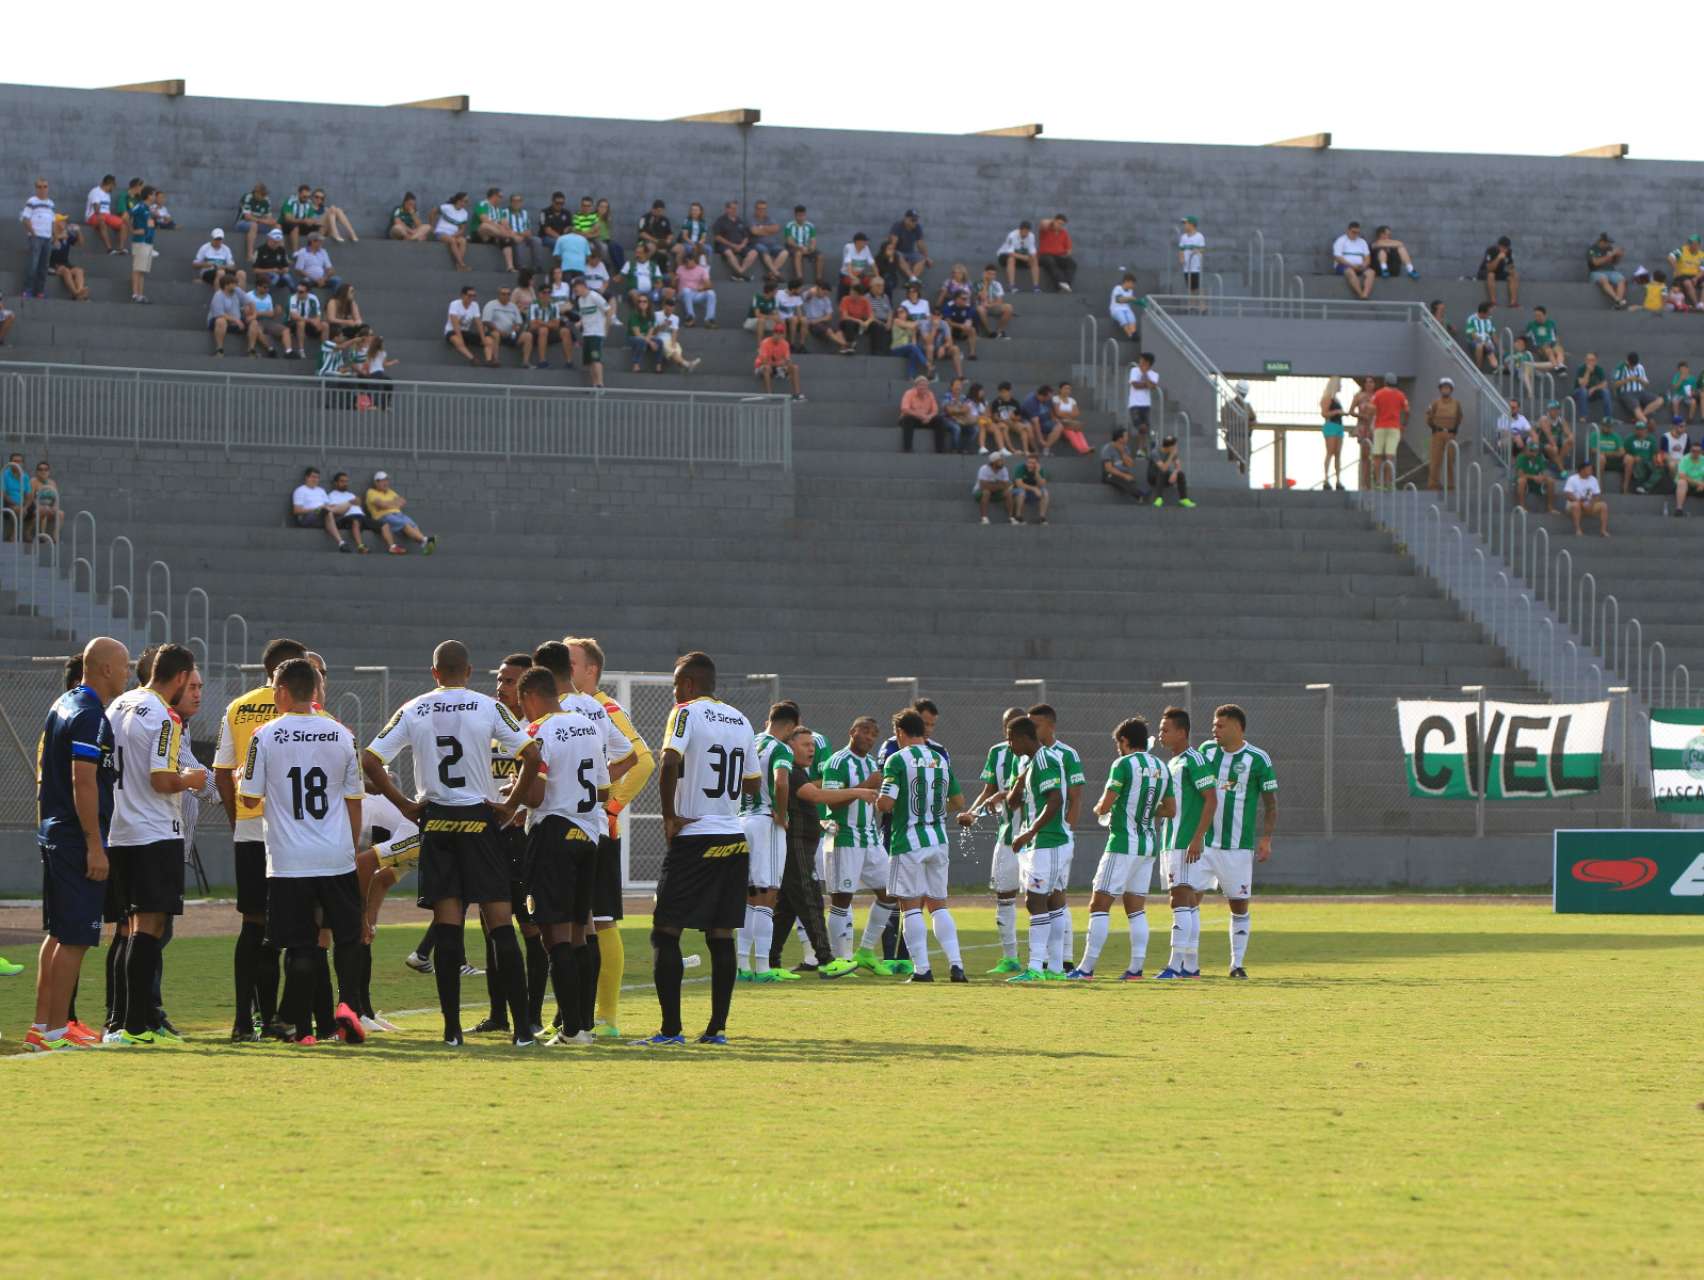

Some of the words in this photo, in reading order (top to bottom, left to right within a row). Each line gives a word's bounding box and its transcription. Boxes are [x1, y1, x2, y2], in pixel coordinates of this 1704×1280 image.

[432, 701, 478, 713] Sicredi
[569, 726, 597, 737] Sicredi
[292, 730, 339, 742] Sicredi
[436, 735, 466, 789] 2
[1412, 710, 1599, 796] CVEL
[286, 766, 329, 820] 18
[577, 758, 597, 813] 5
[702, 744, 744, 800] 30
[911, 777, 947, 817] 83
